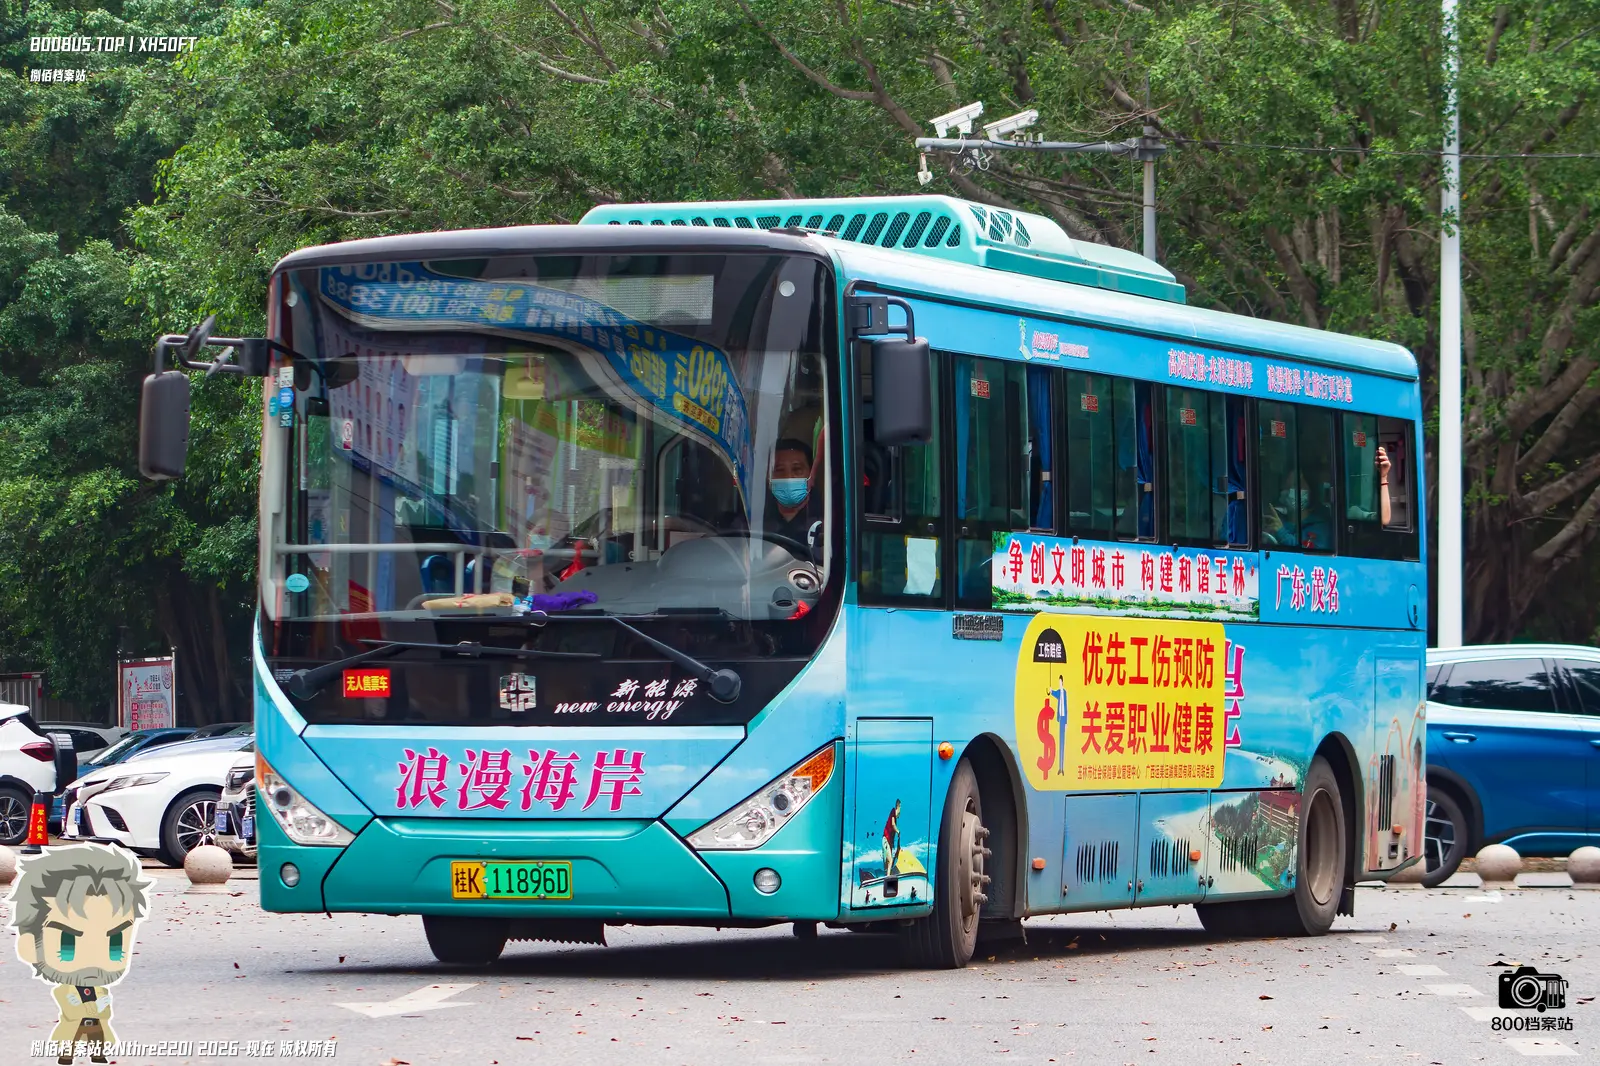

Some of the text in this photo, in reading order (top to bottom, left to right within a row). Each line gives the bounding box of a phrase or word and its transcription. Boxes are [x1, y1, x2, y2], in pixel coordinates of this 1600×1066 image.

[1008, 540, 1246, 596] 争创文明城市 构建和谐玉林
[1038, 642, 1062, 658] 工伤赔偿
[1082, 630, 1215, 690] 优先工伤预防
[346, 675, 388, 691] 无人售票车
[610, 678, 698, 700] 新能源
[554, 700, 684, 720] new energy
[1081, 701, 1214, 757] 关爱职业健康
[395, 747, 647, 812] 浪漫海岸
[493, 867, 570, 893] 11896D
